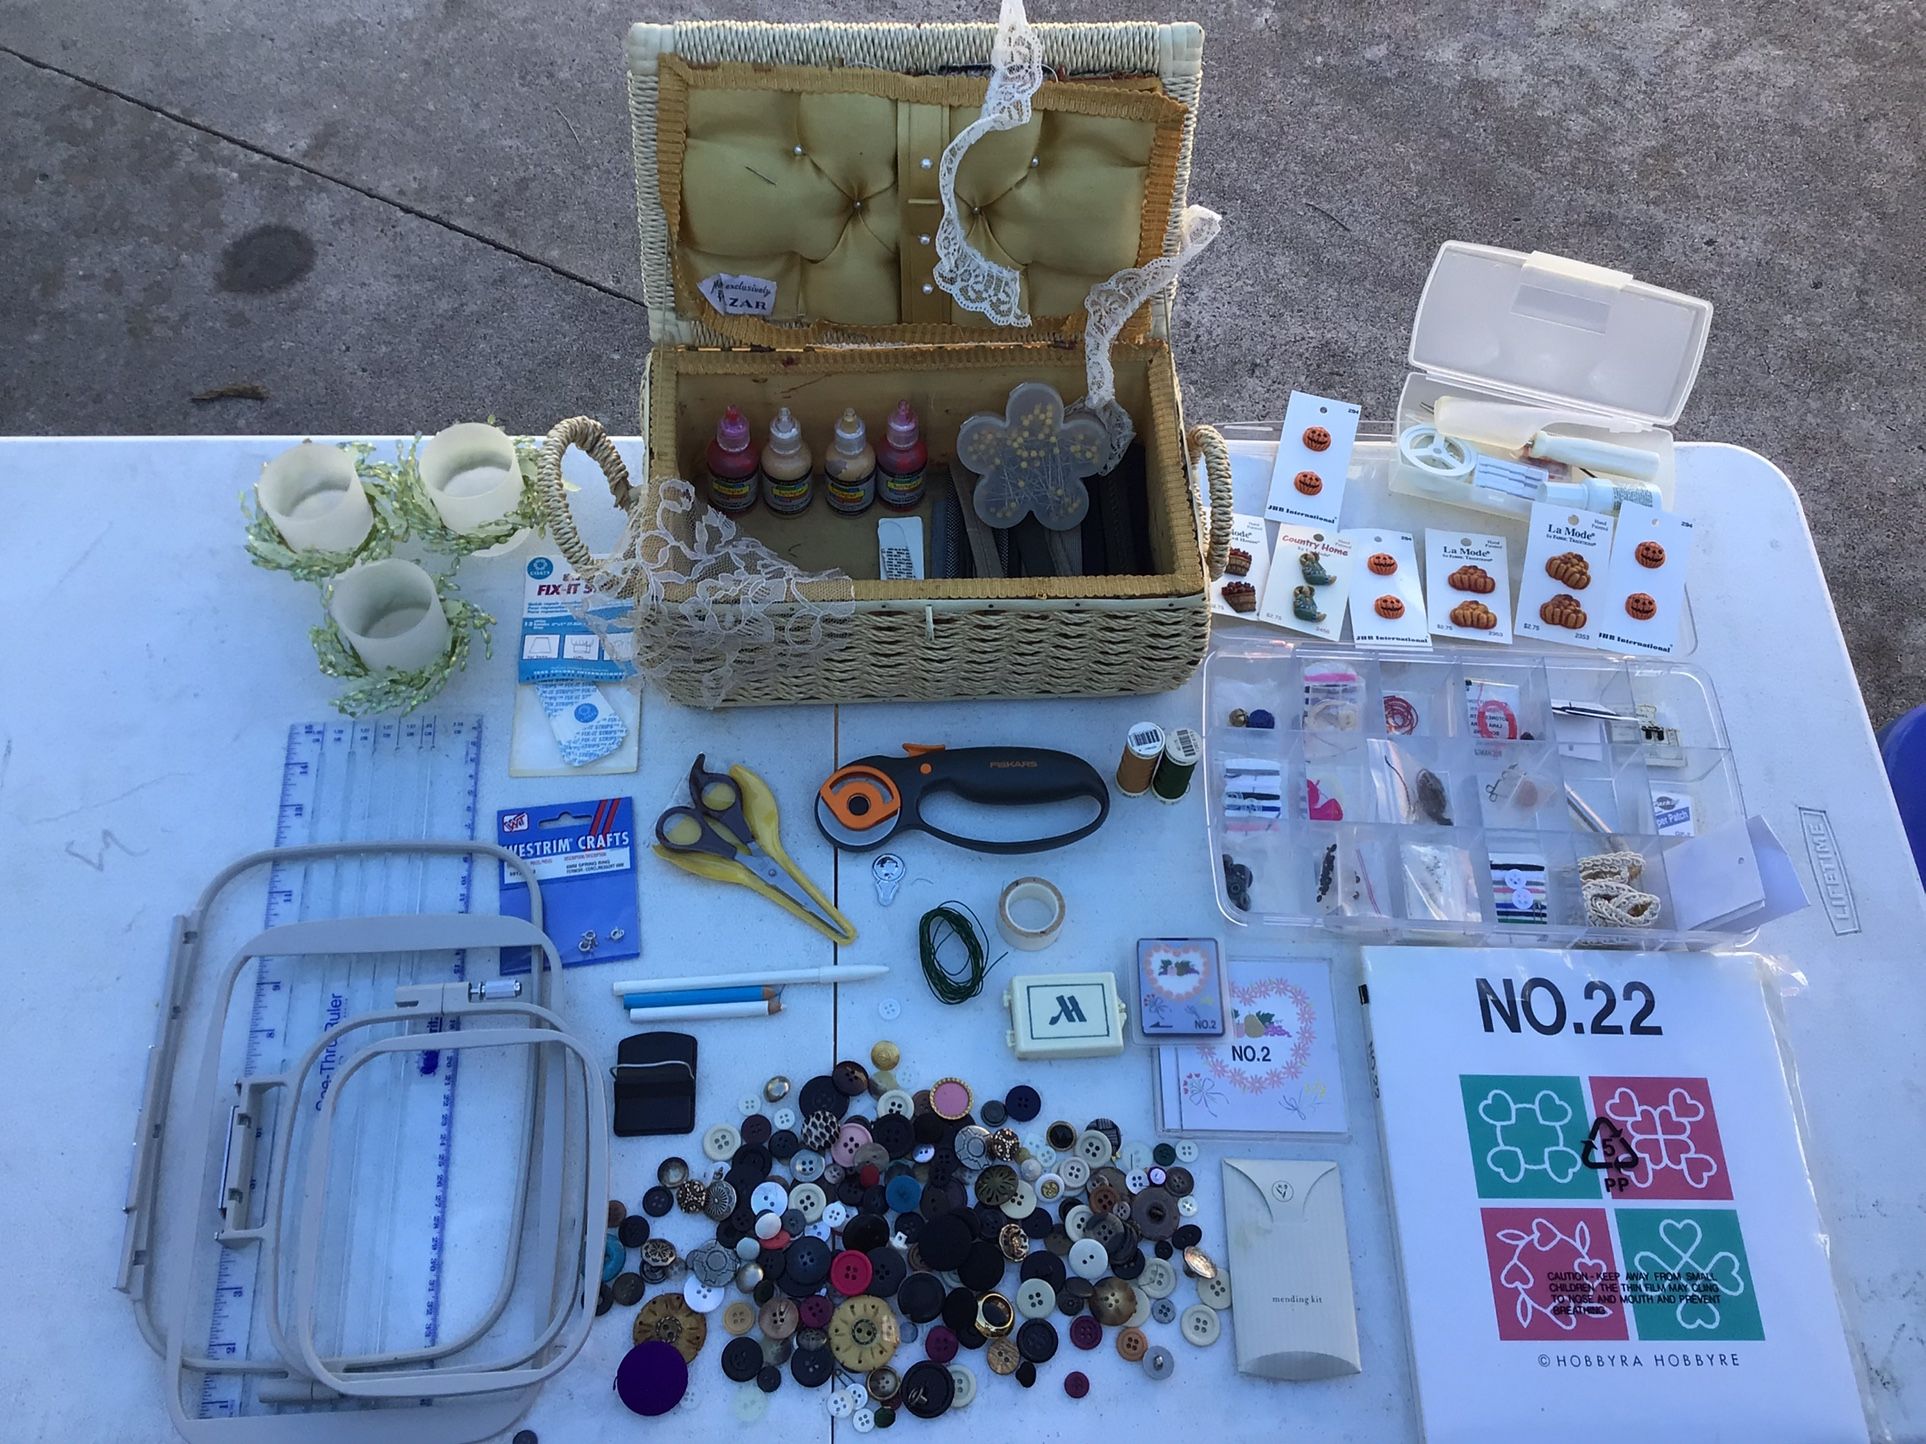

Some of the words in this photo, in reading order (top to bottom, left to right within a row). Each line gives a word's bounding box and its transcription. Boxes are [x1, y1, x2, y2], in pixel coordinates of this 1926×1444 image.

[725, 281, 771, 298] exclusively
[729, 297, 767, 310] ZAR
[1267, 504, 1285, 513] JHB
[1285, 507, 1335, 525] International
[1548, 524, 1562, 535] La
[1282, 534, 1320, 550] Country
[1321, 543, 1349, 557] Home
[1443, 545, 1457, 554] La
[537, 582, 581, 596] FIX-IT
[1523, 622, 1540, 632] $2.75
[1375, 635, 1428, 644] International
[1617, 636, 1671, 653] International
[300, 765, 308, 775] 14
[990, 760, 1038, 769] FISKARS
[295, 807, 303, 817] 13
[577, 831, 630, 851] CRAFTS
[1808, 823, 1850, 921] LIFETIME
[460, 875, 467, 886] 10
[284, 892, 293, 904] 11
[459, 893, 466, 902] 11
[1475, 977, 1664, 1037] NO.22
[1194, 1020, 1217, 1030] NO.2
[1231, 1046, 1272, 1062] NO.2
[446, 1055, 453, 1068] 20
[444, 1074, 451, 1086] 21
[443, 1094, 449, 1107] 22
[441, 1114, 448, 1127] 23
[1601, 1138, 1617, 1158] 5
[438, 1154, 445, 1168] 25
[436, 1174, 444, 1188] 26
[1603, 1177, 1630, 1193] PP
[435, 1195, 442, 1208] 27
[431, 1236, 438, 1251] 29
[429, 1257, 437, 1272] 30
[1547, 1271, 1589, 1281] CAUTION
[1596, 1271, 1620, 1281] KEEP
[1625, 1271, 1649, 1281] AWAY
[1654, 1271, 1681, 1281] FROM
[1686, 1271, 1718, 1281] SMALL
[428, 1279, 436, 1292] 31
[1600, 1283, 1618, 1293] THE
[1621, 1283, 1642, 1293] THIN
[1645, 1283, 1666, 1293] FILM
[1669, 1283, 1688, 1293] MAY
[1692, 1283, 1719, 1293] CLING
[233, 1290, 243, 1298] 3
[1272, 1295, 1309, 1305] mending
[1310, 1295, 1323, 1304] kit
[1551, 1294, 1564, 1304] TO
[1568, 1294, 1594, 1304] NOSE
[1597, 1294, 1617, 1304] AND
[1619, 1294, 1654, 1304] MOUTH
[1657, 1294, 1676, 1304] AND
[1679, 1294, 1721, 1304] PREVENT
[426, 1300, 433, 1316] 32
[424, 1322, 432, 1338] 33
[225, 1346, 236, 1354] 2
[1556, 1354, 1644, 1368] HOBBYRA
[1654, 1353, 1740, 1367] HOBBYRE
